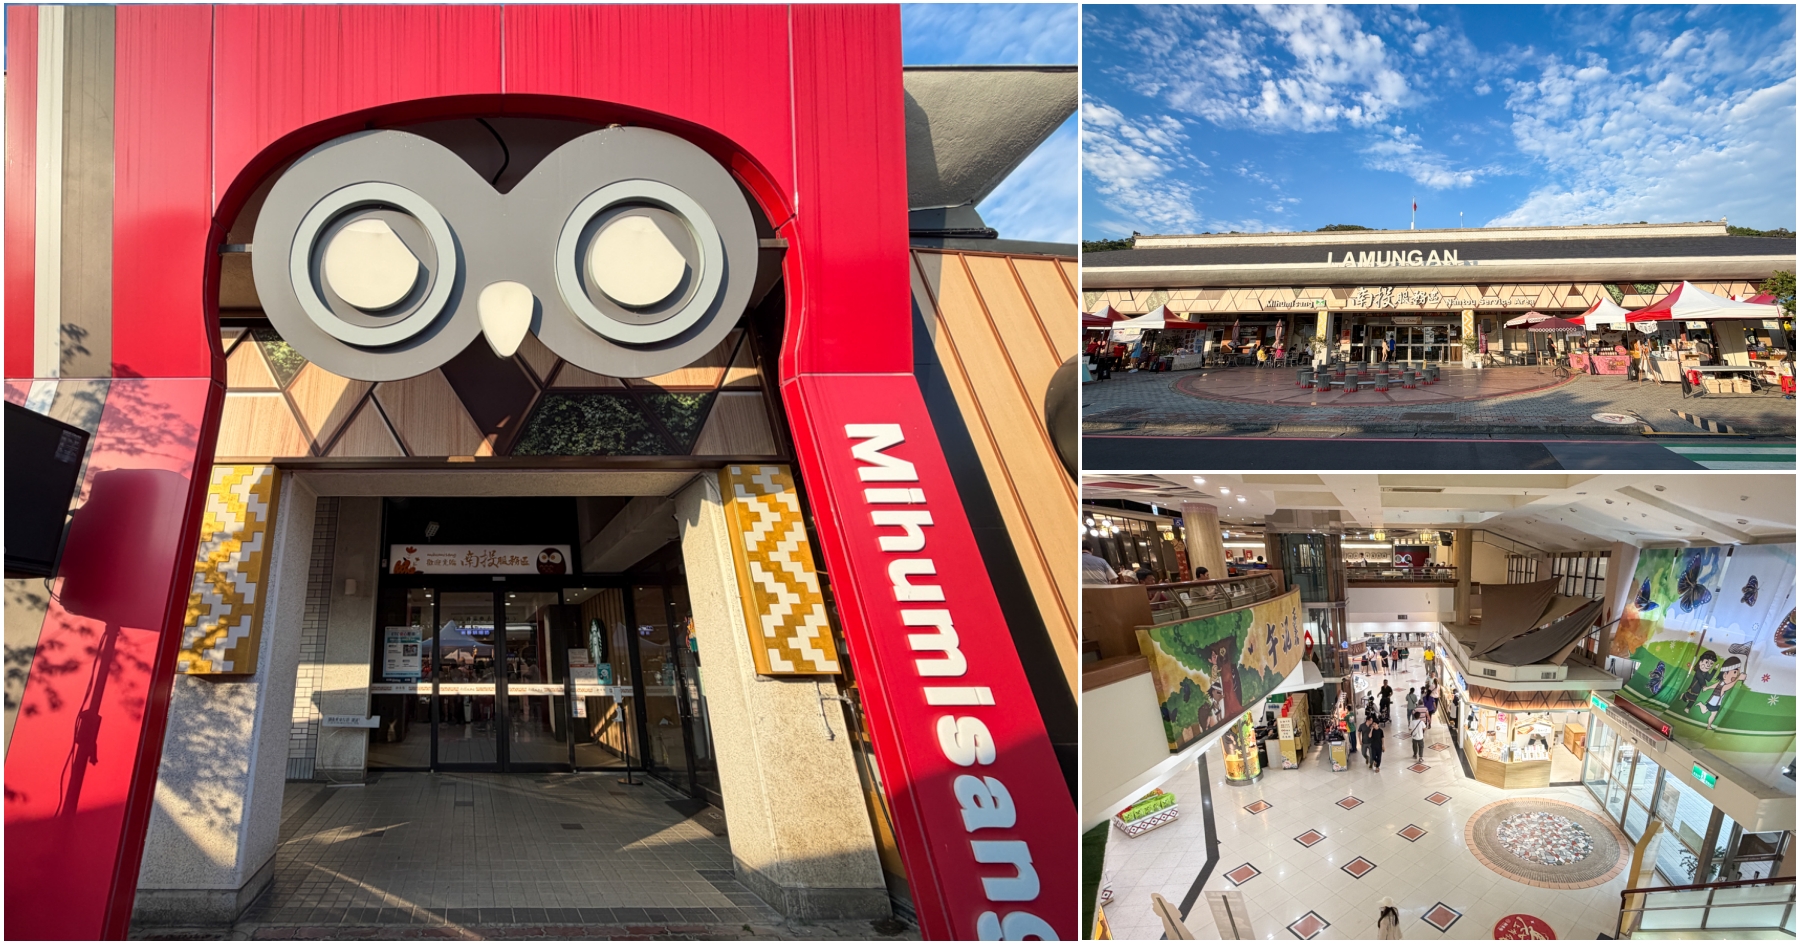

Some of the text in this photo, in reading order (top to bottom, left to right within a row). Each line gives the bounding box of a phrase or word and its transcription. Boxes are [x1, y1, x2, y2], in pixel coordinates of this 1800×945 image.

[1327, 249, 1458, 268] LAMUNGAN
[1352, 286, 1440, 309] 南投服務區
[460, 549, 530, 569] 南投服務區
